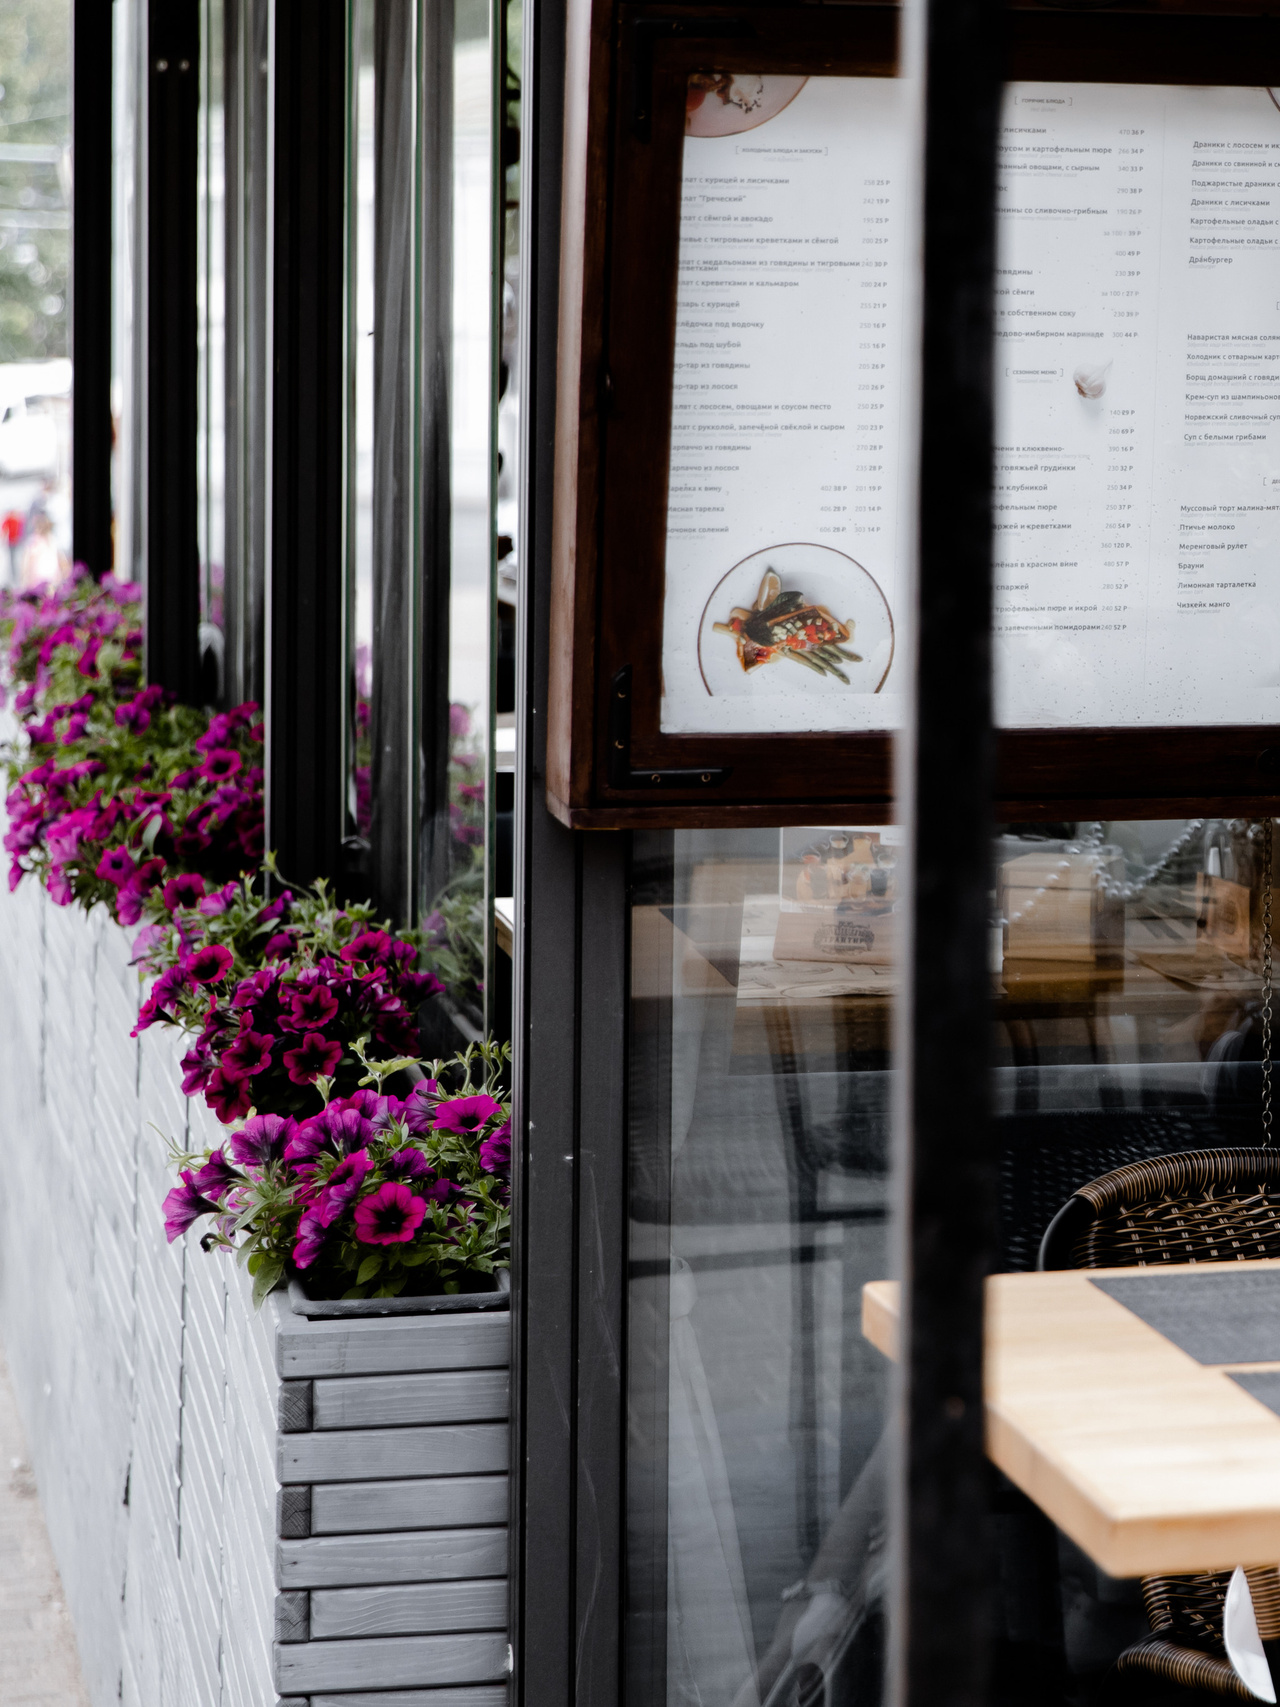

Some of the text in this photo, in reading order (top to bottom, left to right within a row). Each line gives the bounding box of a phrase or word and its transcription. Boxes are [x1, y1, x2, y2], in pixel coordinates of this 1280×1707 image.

[1192, 141, 1225, 150] Драники
[1192, 160, 1222, 168] Драники
[1191, 180, 1243, 188] Поджаристые
[1244, 181, 1275, 189] драники
[1190, 199, 1223, 207] Драники
[1190, 217, 1245, 226] Картофельные
[1189, 237, 1245, 246] Картофельные
[1187, 333, 1230, 342] Наваристая
[1186, 353, 1221, 362] Холодник
[1227, 354, 1263, 362] отварным
[1185, 373, 1206, 382] Борщ
[1207, 373, 1247, 382] домашний
[1185, 393, 1219, 402] Крем-суп
[1184, 413, 1228, 422] Норвежский
[1269, 414, 1280, 422] суп
[1184, 433, 1197, 442] Суп
[1235, 433, 1266, 442] грибами
[1180, 504, 1217, 513] Муссовый
[1219, 505, 1235, 513] торт
[1179, 523, 1206, 531] Птичье
[1178, 543, 1225, 552] Меренговый
[1178, 562, 1204, 571] Брауни
[1177, 581, 1256, 590] Лимонная тарталетка
